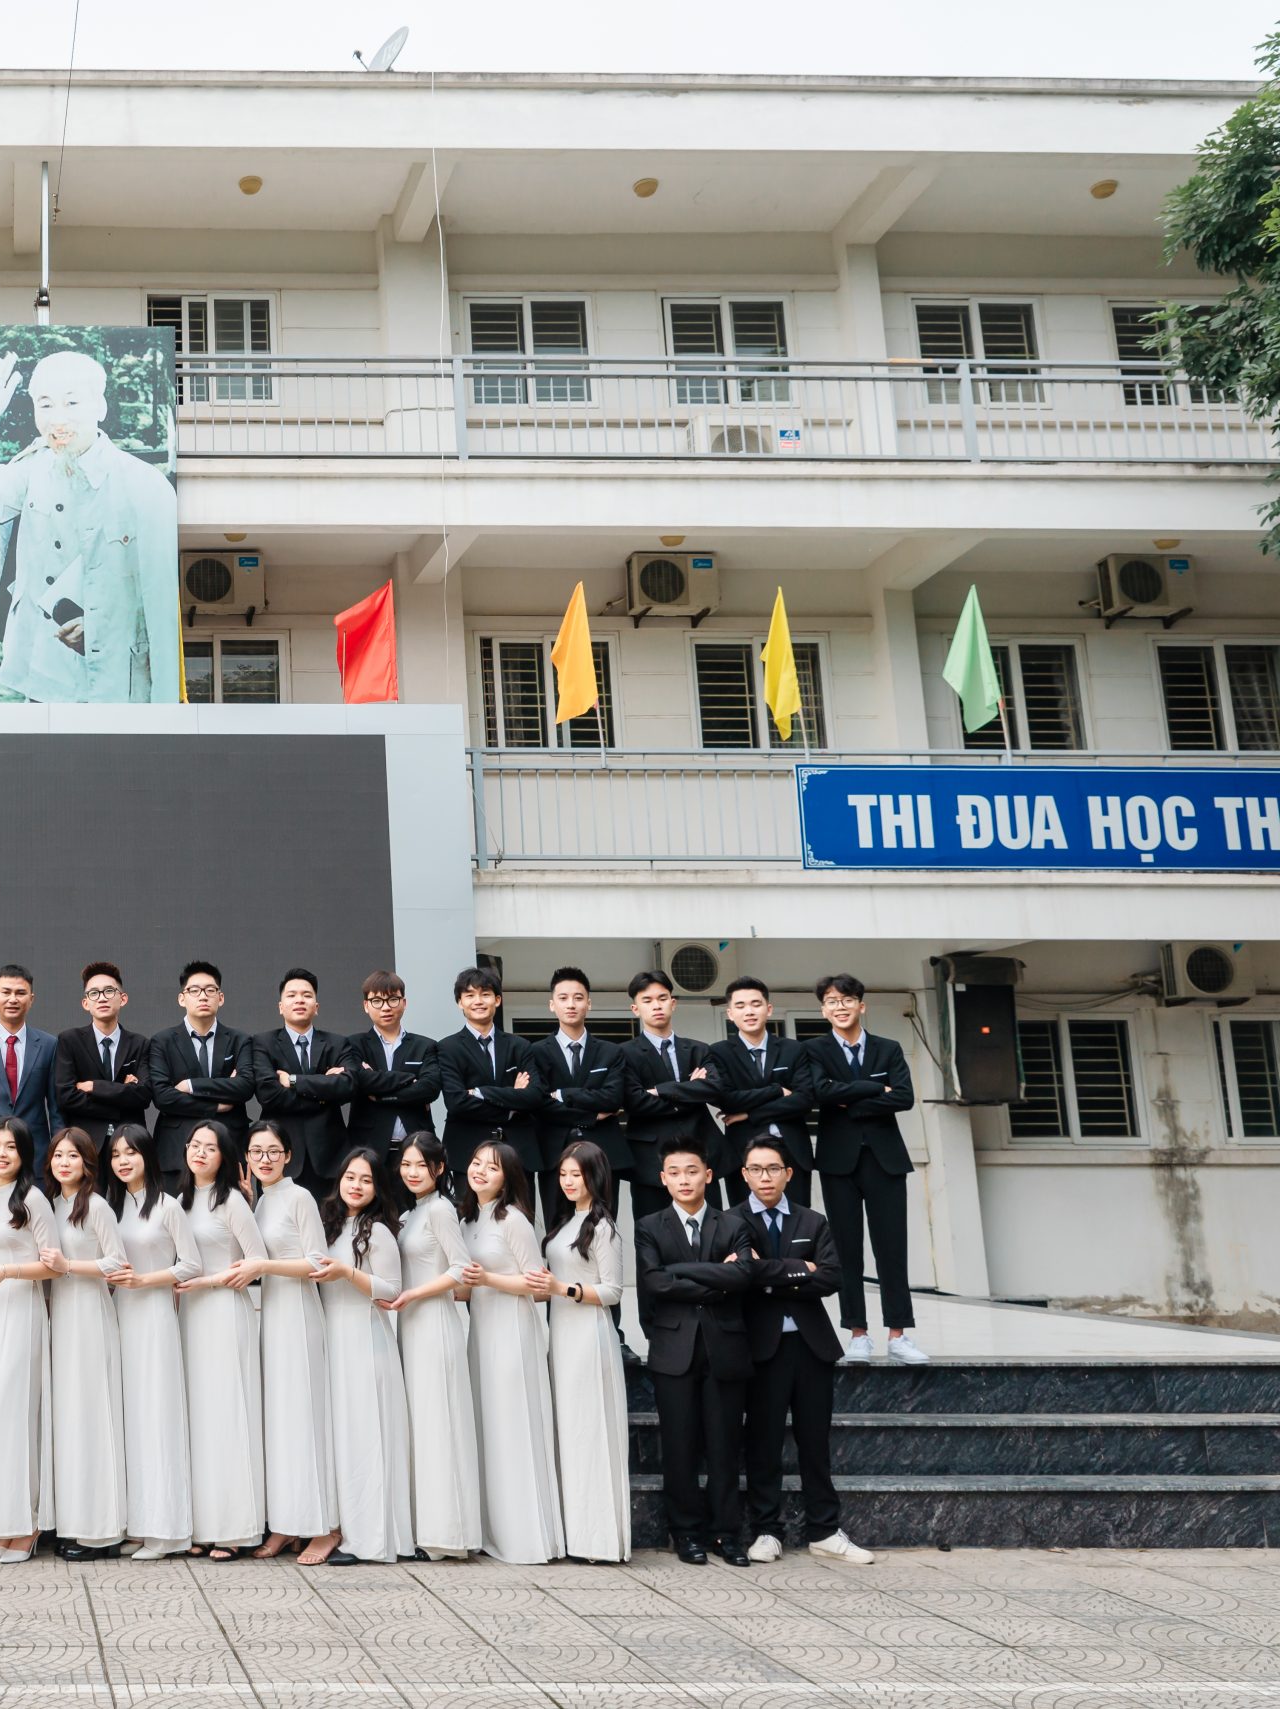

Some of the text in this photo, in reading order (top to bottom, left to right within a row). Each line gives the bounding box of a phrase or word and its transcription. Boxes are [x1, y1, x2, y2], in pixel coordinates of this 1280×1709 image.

[847, 794, 935, 849] THI
[956, 795, 1068, 850] ĐUA
[1087, 795, 1198, 863] HỌC
